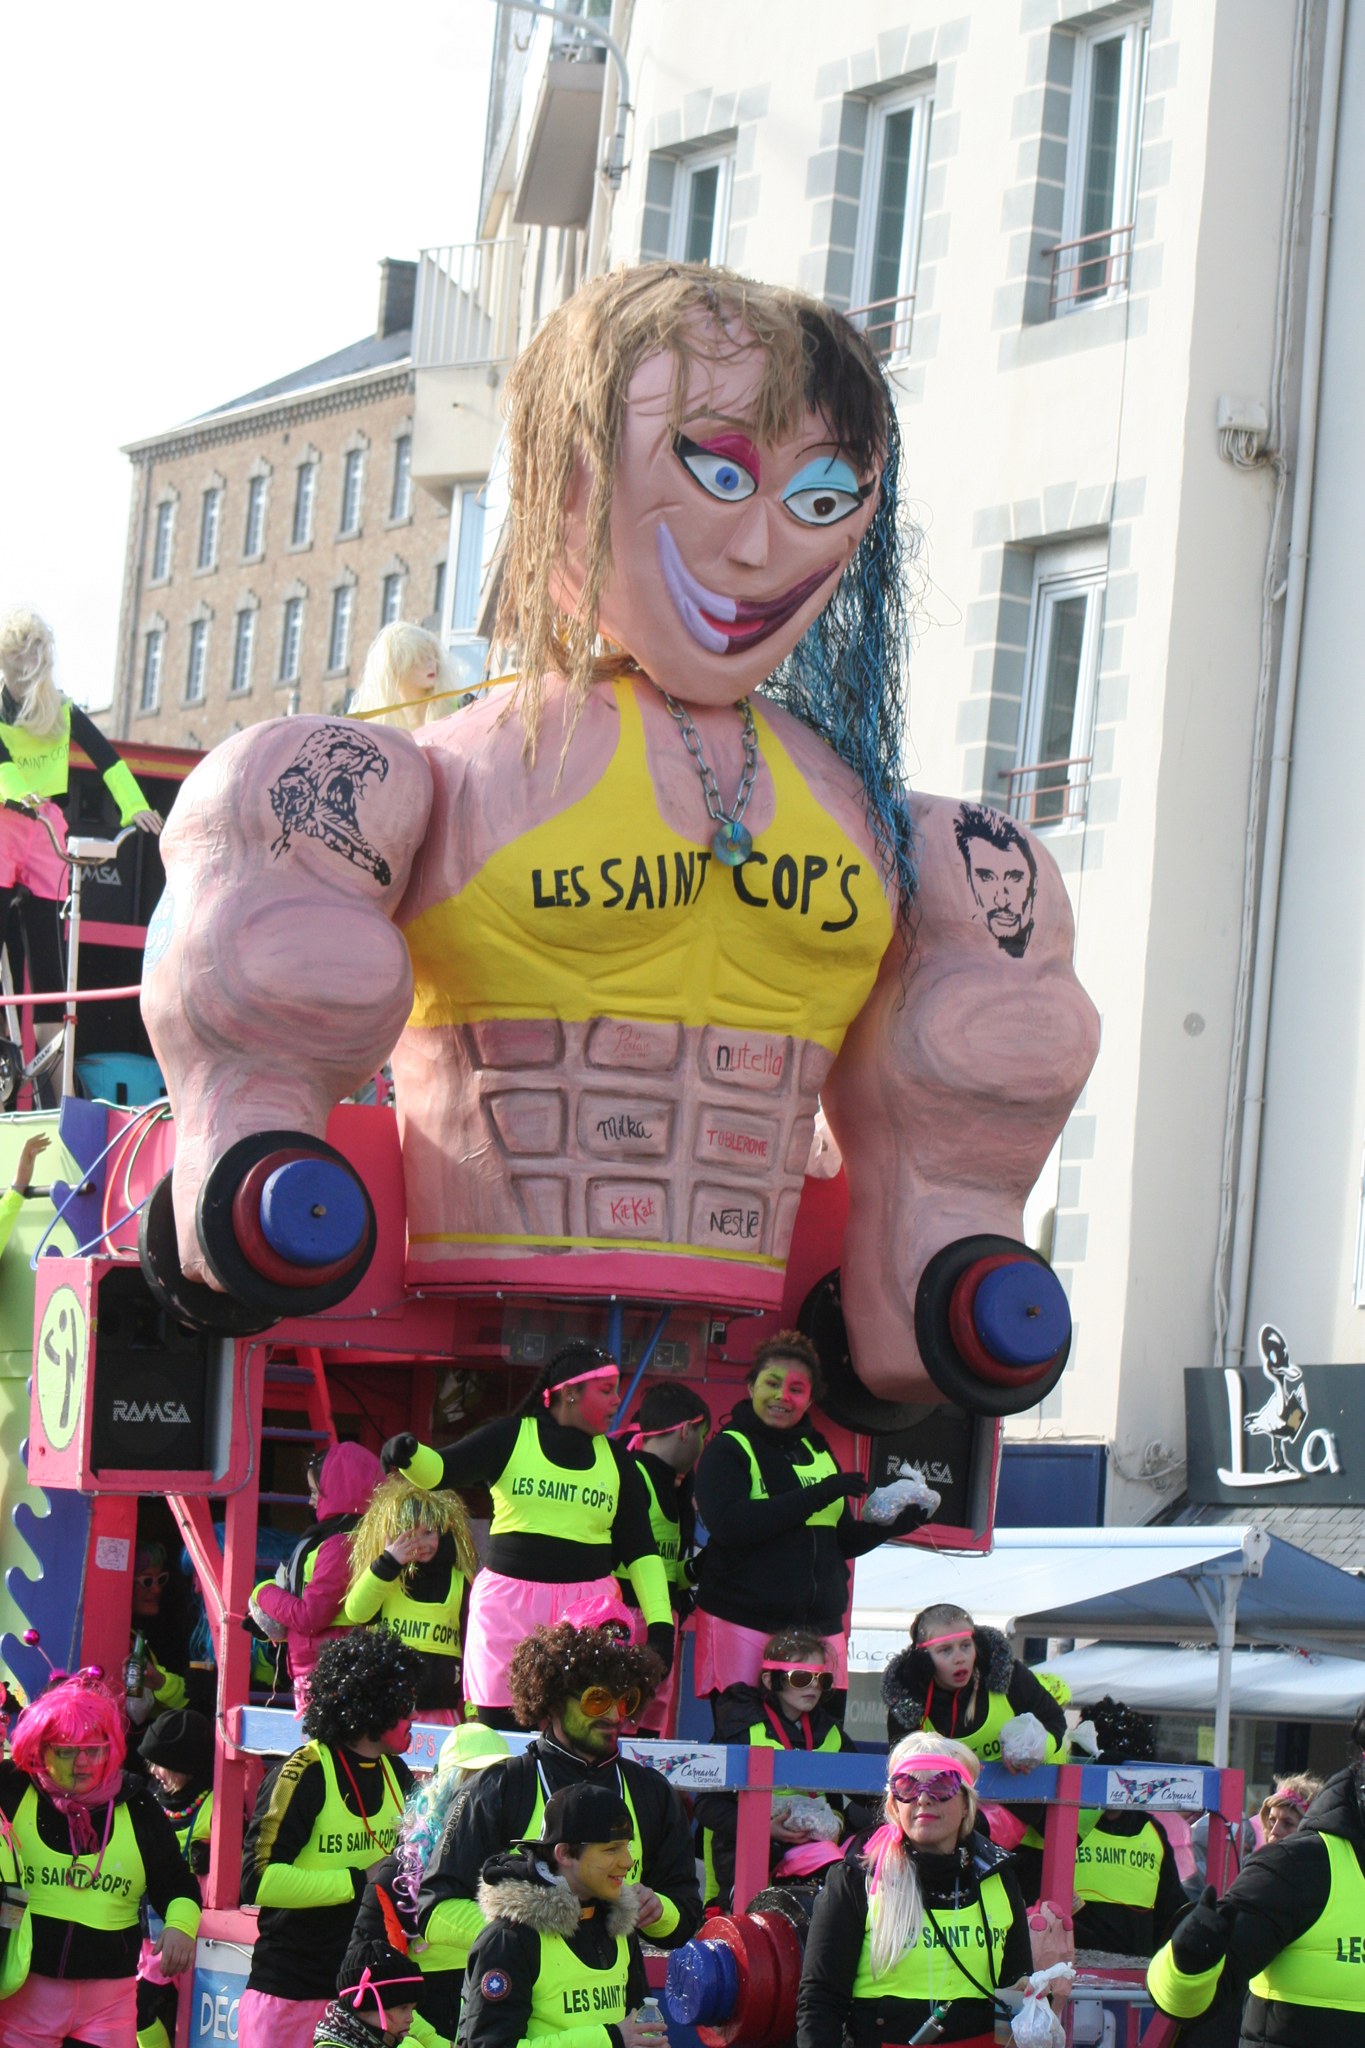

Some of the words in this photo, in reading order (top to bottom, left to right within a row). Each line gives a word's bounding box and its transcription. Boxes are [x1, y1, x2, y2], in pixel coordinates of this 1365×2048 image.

[532, 866, 590, 908] LES
[600, 851, 712, 910] SAINT
[732, 852, 861, 932] COP'S
[717, 1040, 783, 1076] nutella
[597, 1114, 652, 1141] Milka
[113, 1400, 191, 1423] RAMSA
[1217, 1368, 1340, 1487] La
[512, 1477, 534, 1496] LES
[538, 1479, 578, 1503] SAINT
[582, 1487, 613, 1513] COP'S
[392, 1618, 430, 1640] SAINT
[433, 1623, 458, 1647] COP'S
[847, 1641, 896, 1661] lace
[681, 1764, 720, 1779] Carnaval
[1161, 1787, 1197, 1801] Carnaval
[319, 1833, 343, 1853] LES
[347, 1831, 377, 1852] SAINT
[1075, 1846, 1092, 1864] ES
[1096, 1846, 1127, 1866] SAINT
[1130, 1849, 1156, 1870] COP'S
[41, 1867, 87, 1890] SAINT
[91, 1871, 132, 1897] COP'S
[922, 1925, 970, 1949] SAINT
[563, 1988, 590, 2014] LES
[592, 1984, 620, 2011] SAINT
